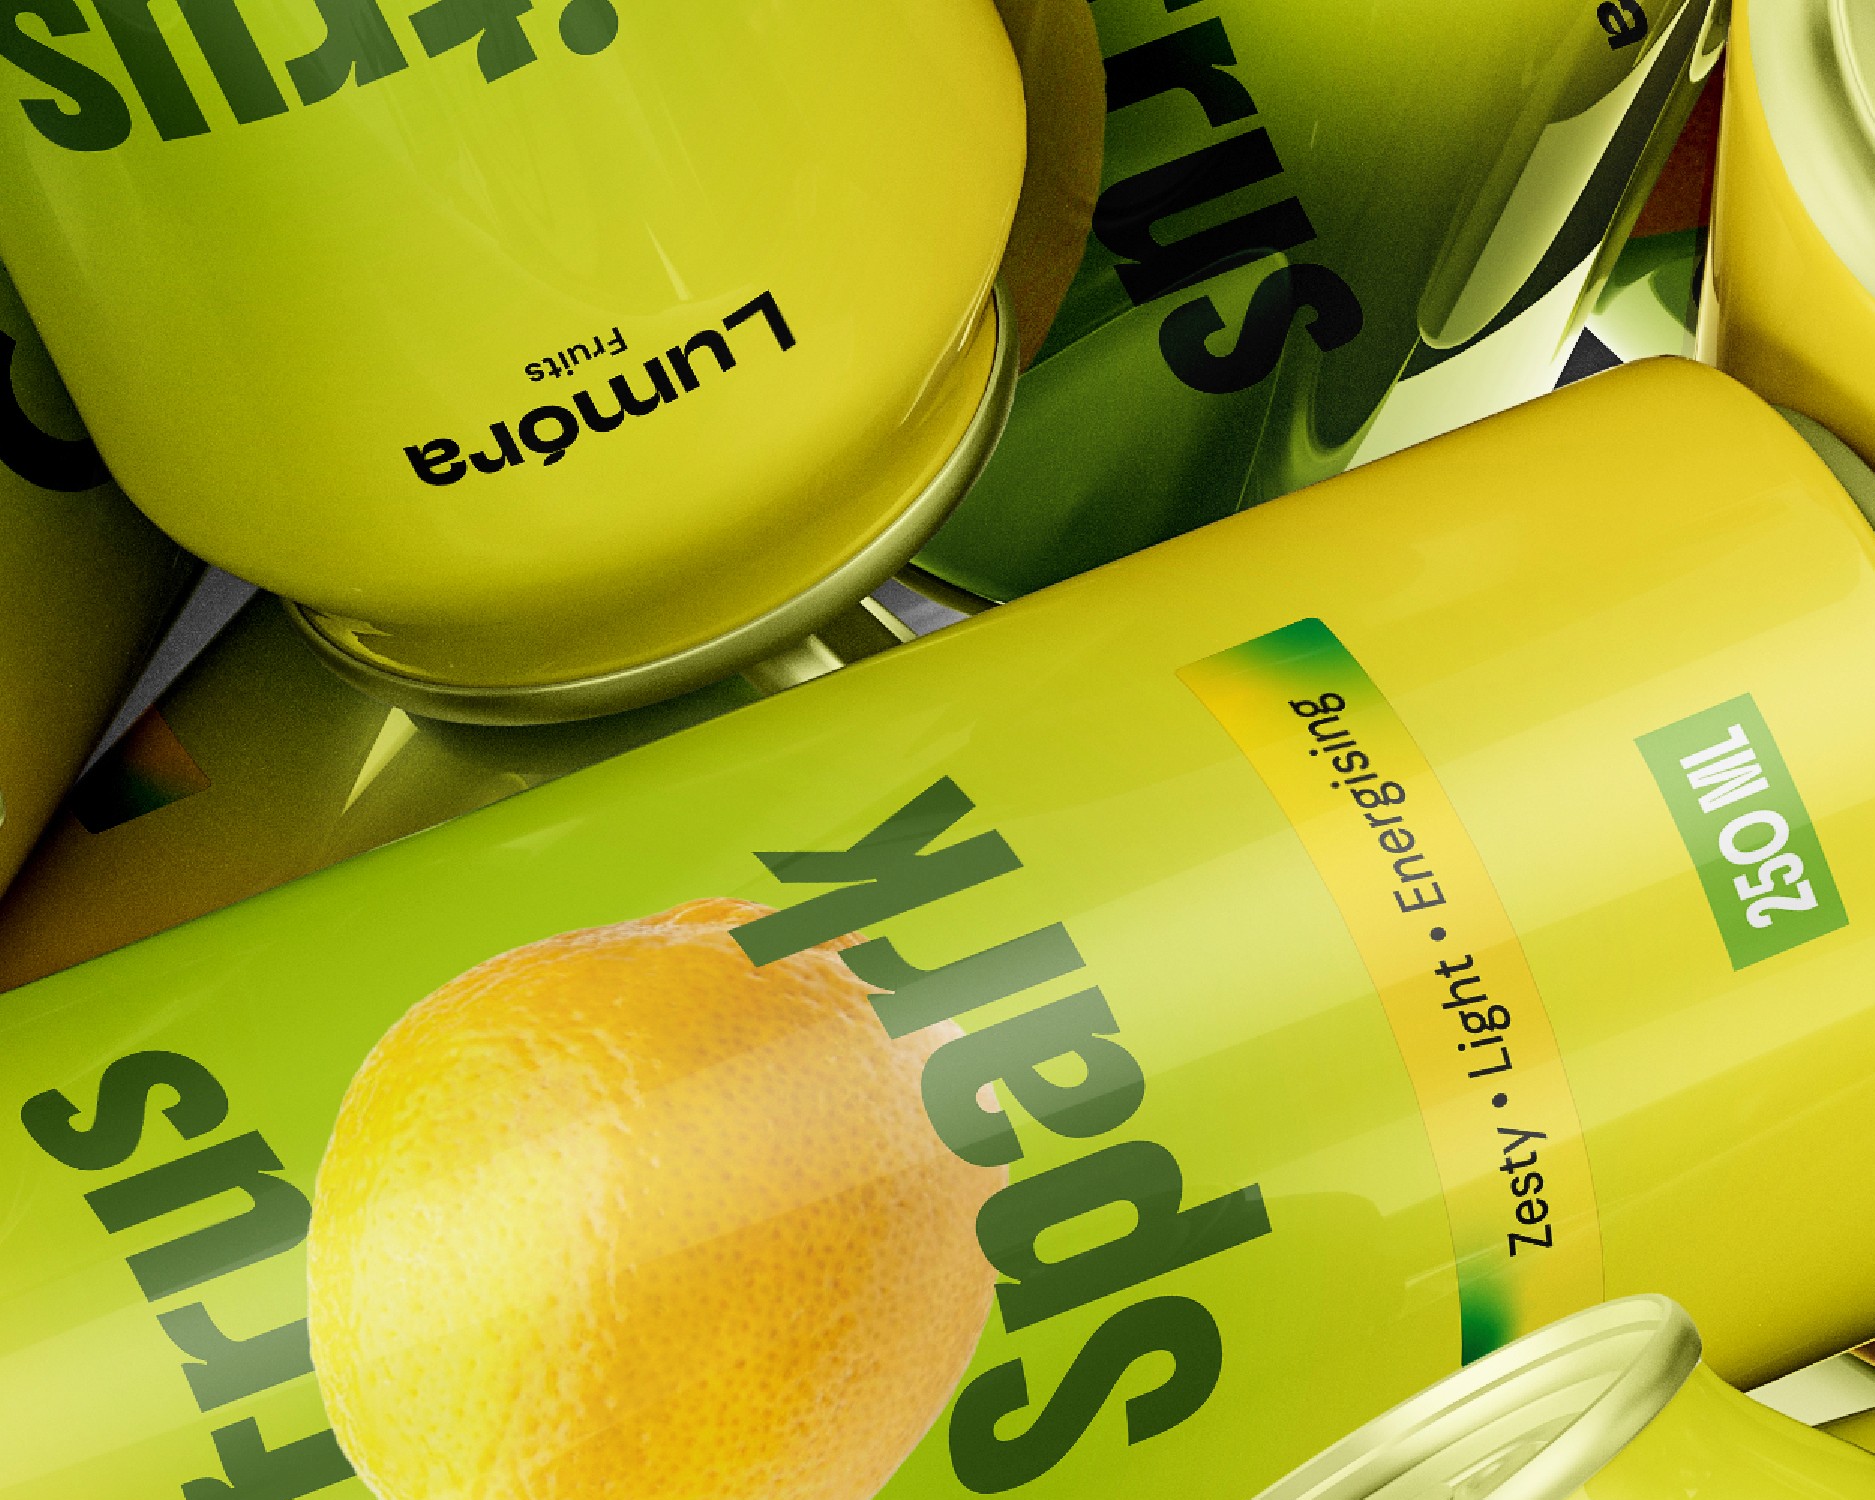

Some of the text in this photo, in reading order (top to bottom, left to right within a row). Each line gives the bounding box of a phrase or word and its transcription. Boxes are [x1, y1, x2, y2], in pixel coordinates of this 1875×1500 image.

[404, 291, 796, 487] Lumóra
[524, 326, 626, 381] Fruits
[1680, 725, 1819, 932] 250 ML
[1289, 691, 1552, 1258] Zesty Light Energising
[728, 776, 1272, 1495] Spark
